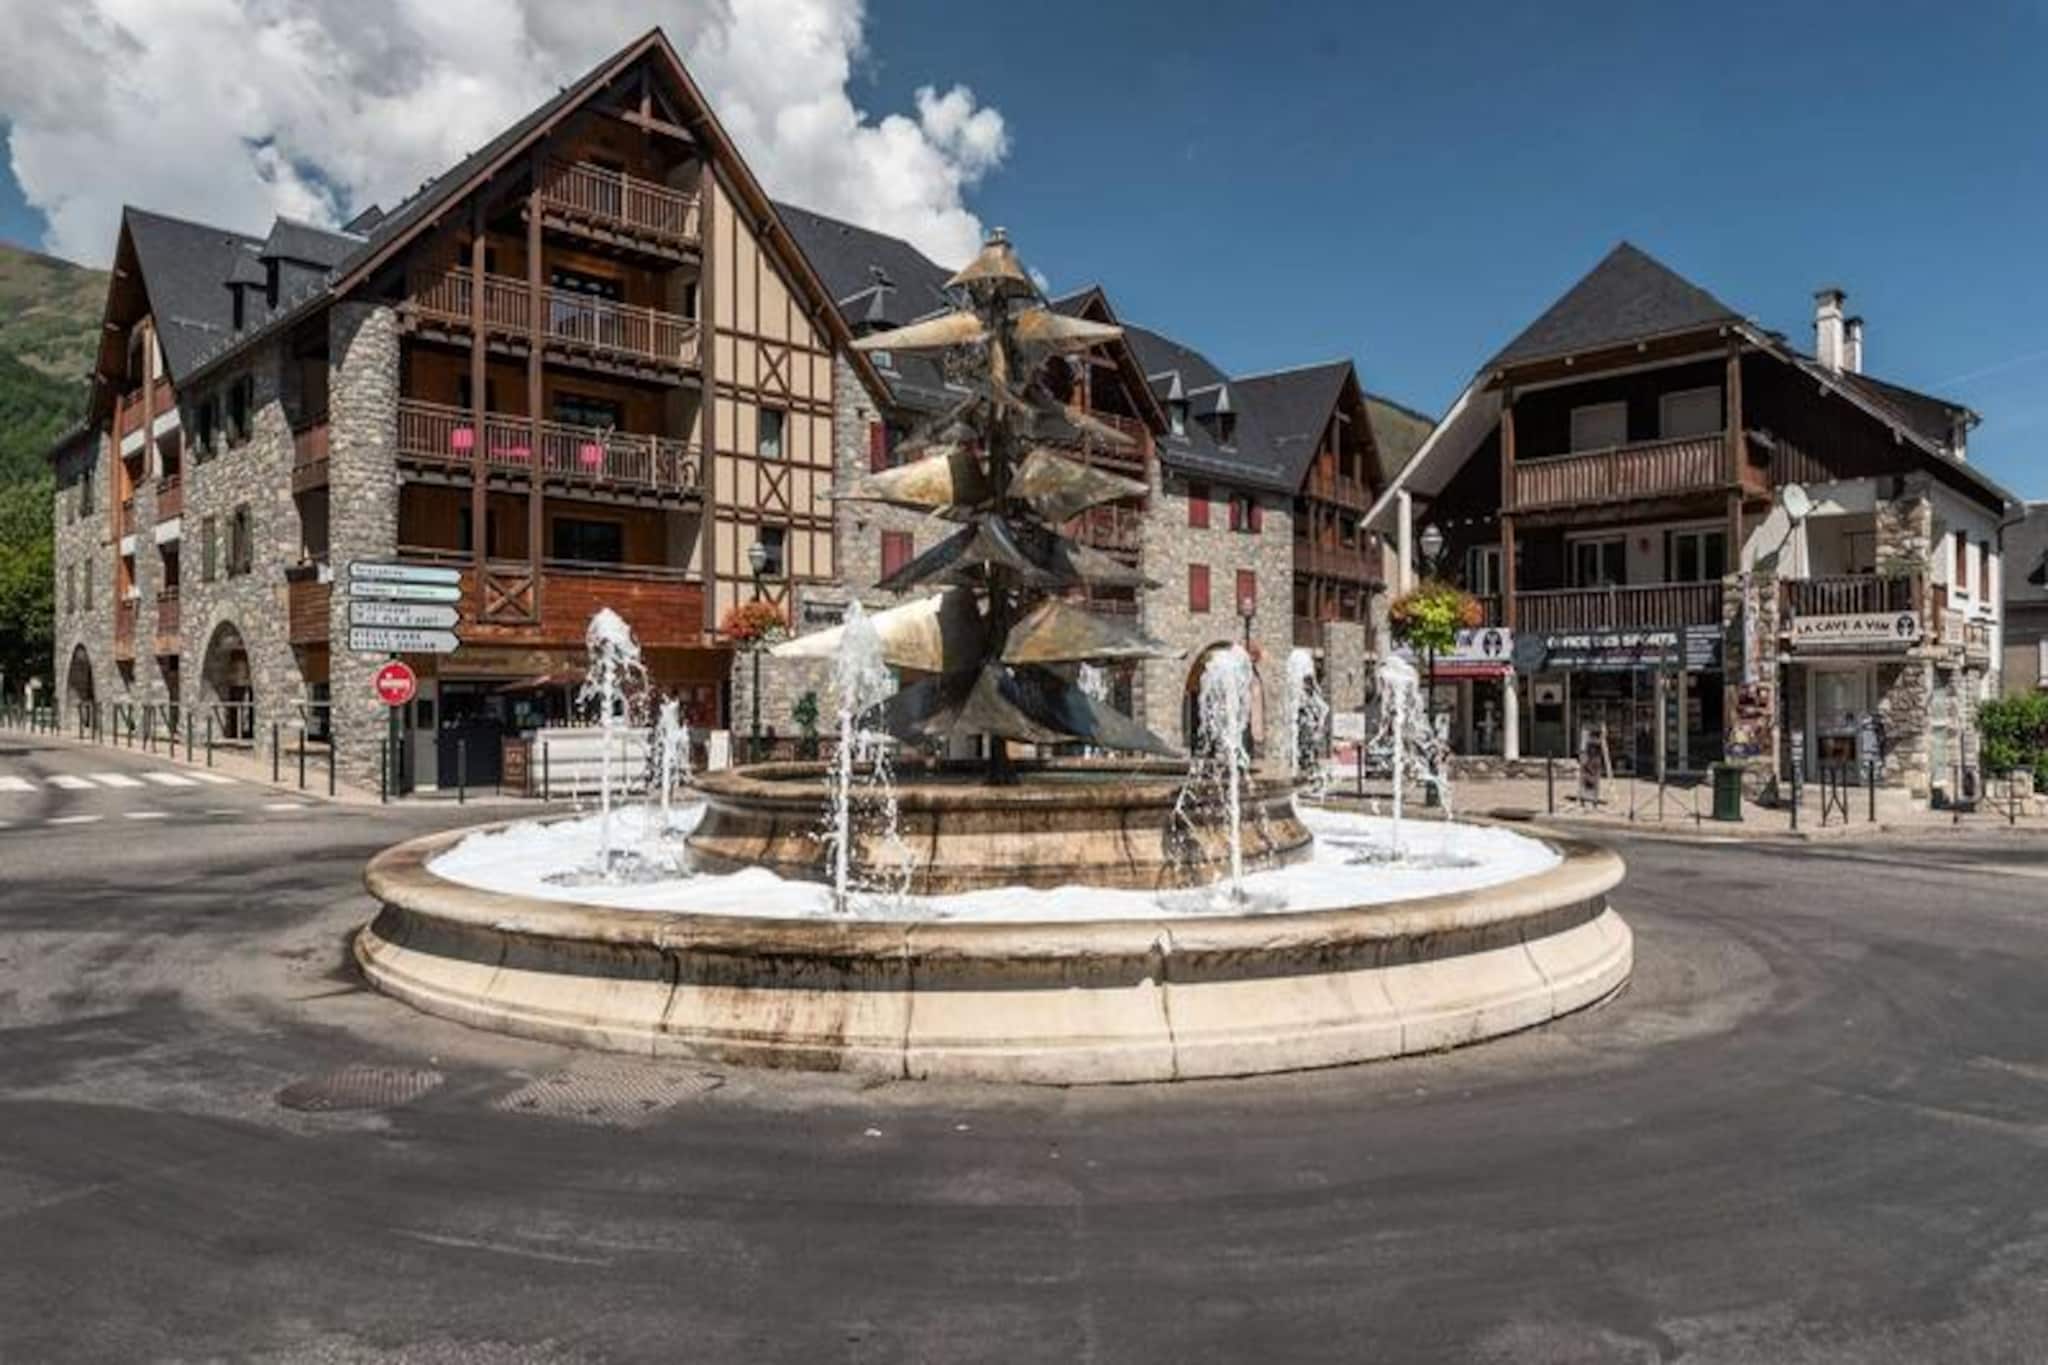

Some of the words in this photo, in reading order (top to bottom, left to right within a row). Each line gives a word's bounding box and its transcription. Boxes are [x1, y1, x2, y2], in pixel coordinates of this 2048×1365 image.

[1797, 624, 1813, 634] LA
[1815, 621, 1848, 632] CAVE
[1867, 620, 1890, 631] VIN
[1622, 632, 1678, 648] SPORTS
